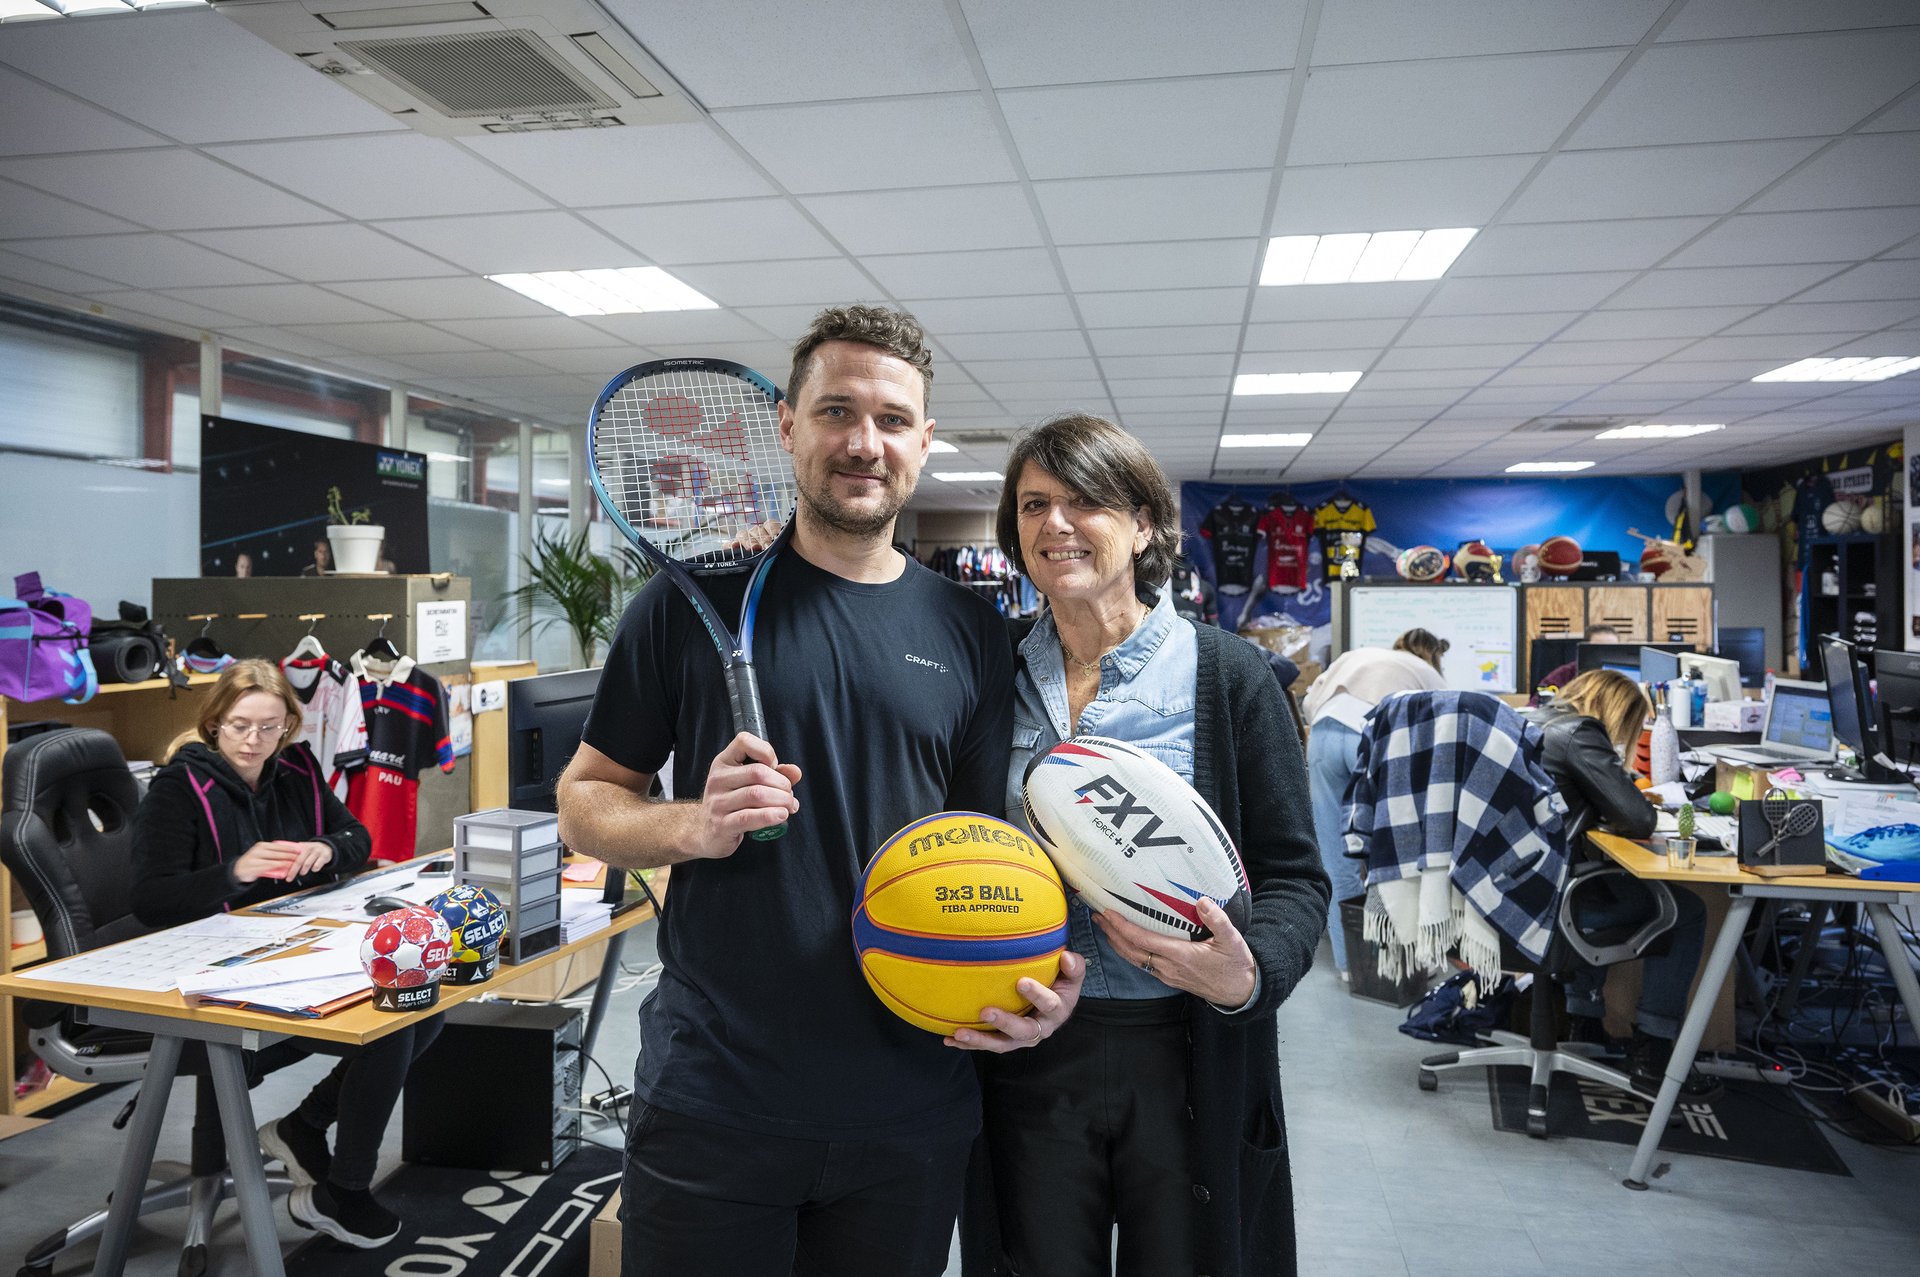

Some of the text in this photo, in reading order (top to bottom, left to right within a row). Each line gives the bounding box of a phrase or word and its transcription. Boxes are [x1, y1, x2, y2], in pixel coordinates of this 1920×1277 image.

[905, 653, 940, 670] CRAFT
[378, 771, 403, 787] PAU
[1073, 773, 1188, 848] FXV
[1091, 816, 1117, 841] FORCE
[908, 823, 1035, 858] molten
[935, 885, 1024, 902] 3x3 BALL
[941, 904, 1020, 914] FIBA APPROVED
[463, 913, 506, 946] SELECT
[397, 988, 432, 1003] SELECT
